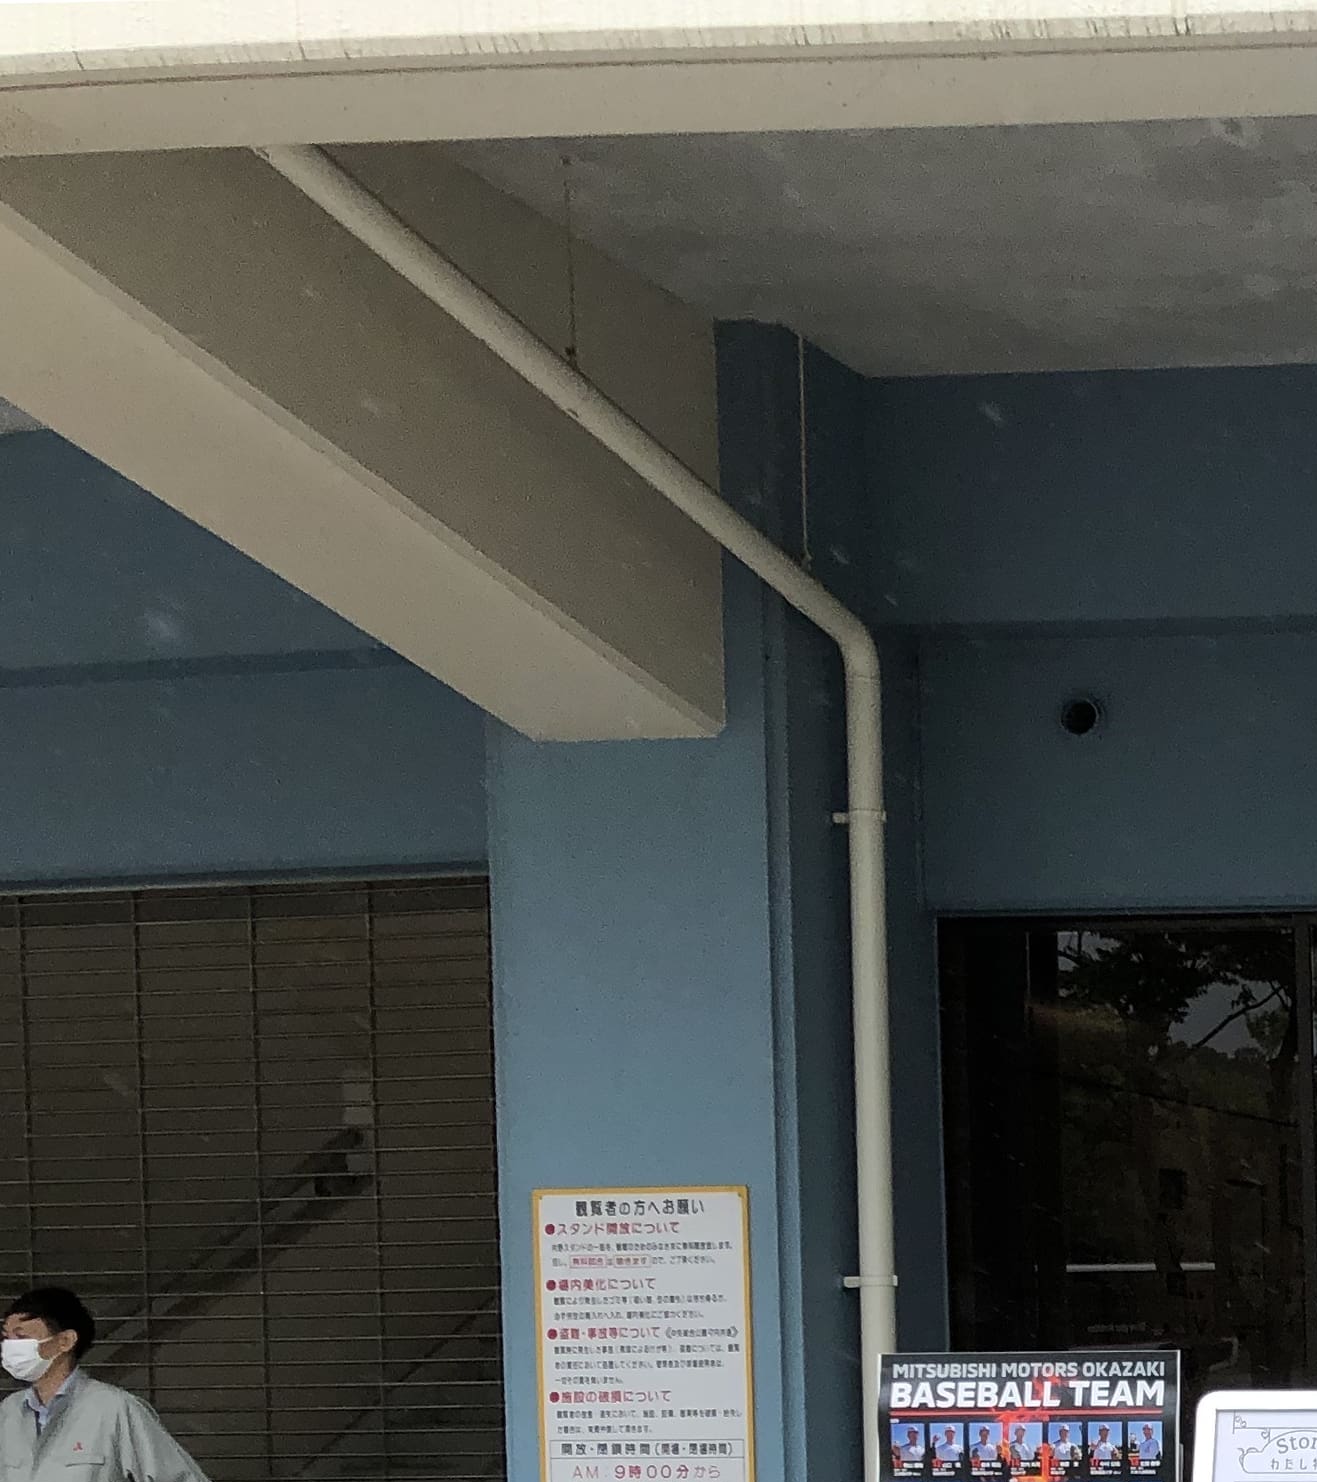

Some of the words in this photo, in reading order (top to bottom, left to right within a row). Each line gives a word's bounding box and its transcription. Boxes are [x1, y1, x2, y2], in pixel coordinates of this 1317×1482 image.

[575, 1199, 705, 1217] 観覧者の方へお願い
[557, 1222, 680, 1235] スタンド開放について
[892, 1363, 996, 1379] MITSUBISHI
[1001, 1362, 1078, 1378] MOTORS
[1082, 1361, 1165, 1377] OKAZAKI
[889, 1380, 1061, 1408] BASEBALL
[1069, 1380, 1165, 1406] TEAM
